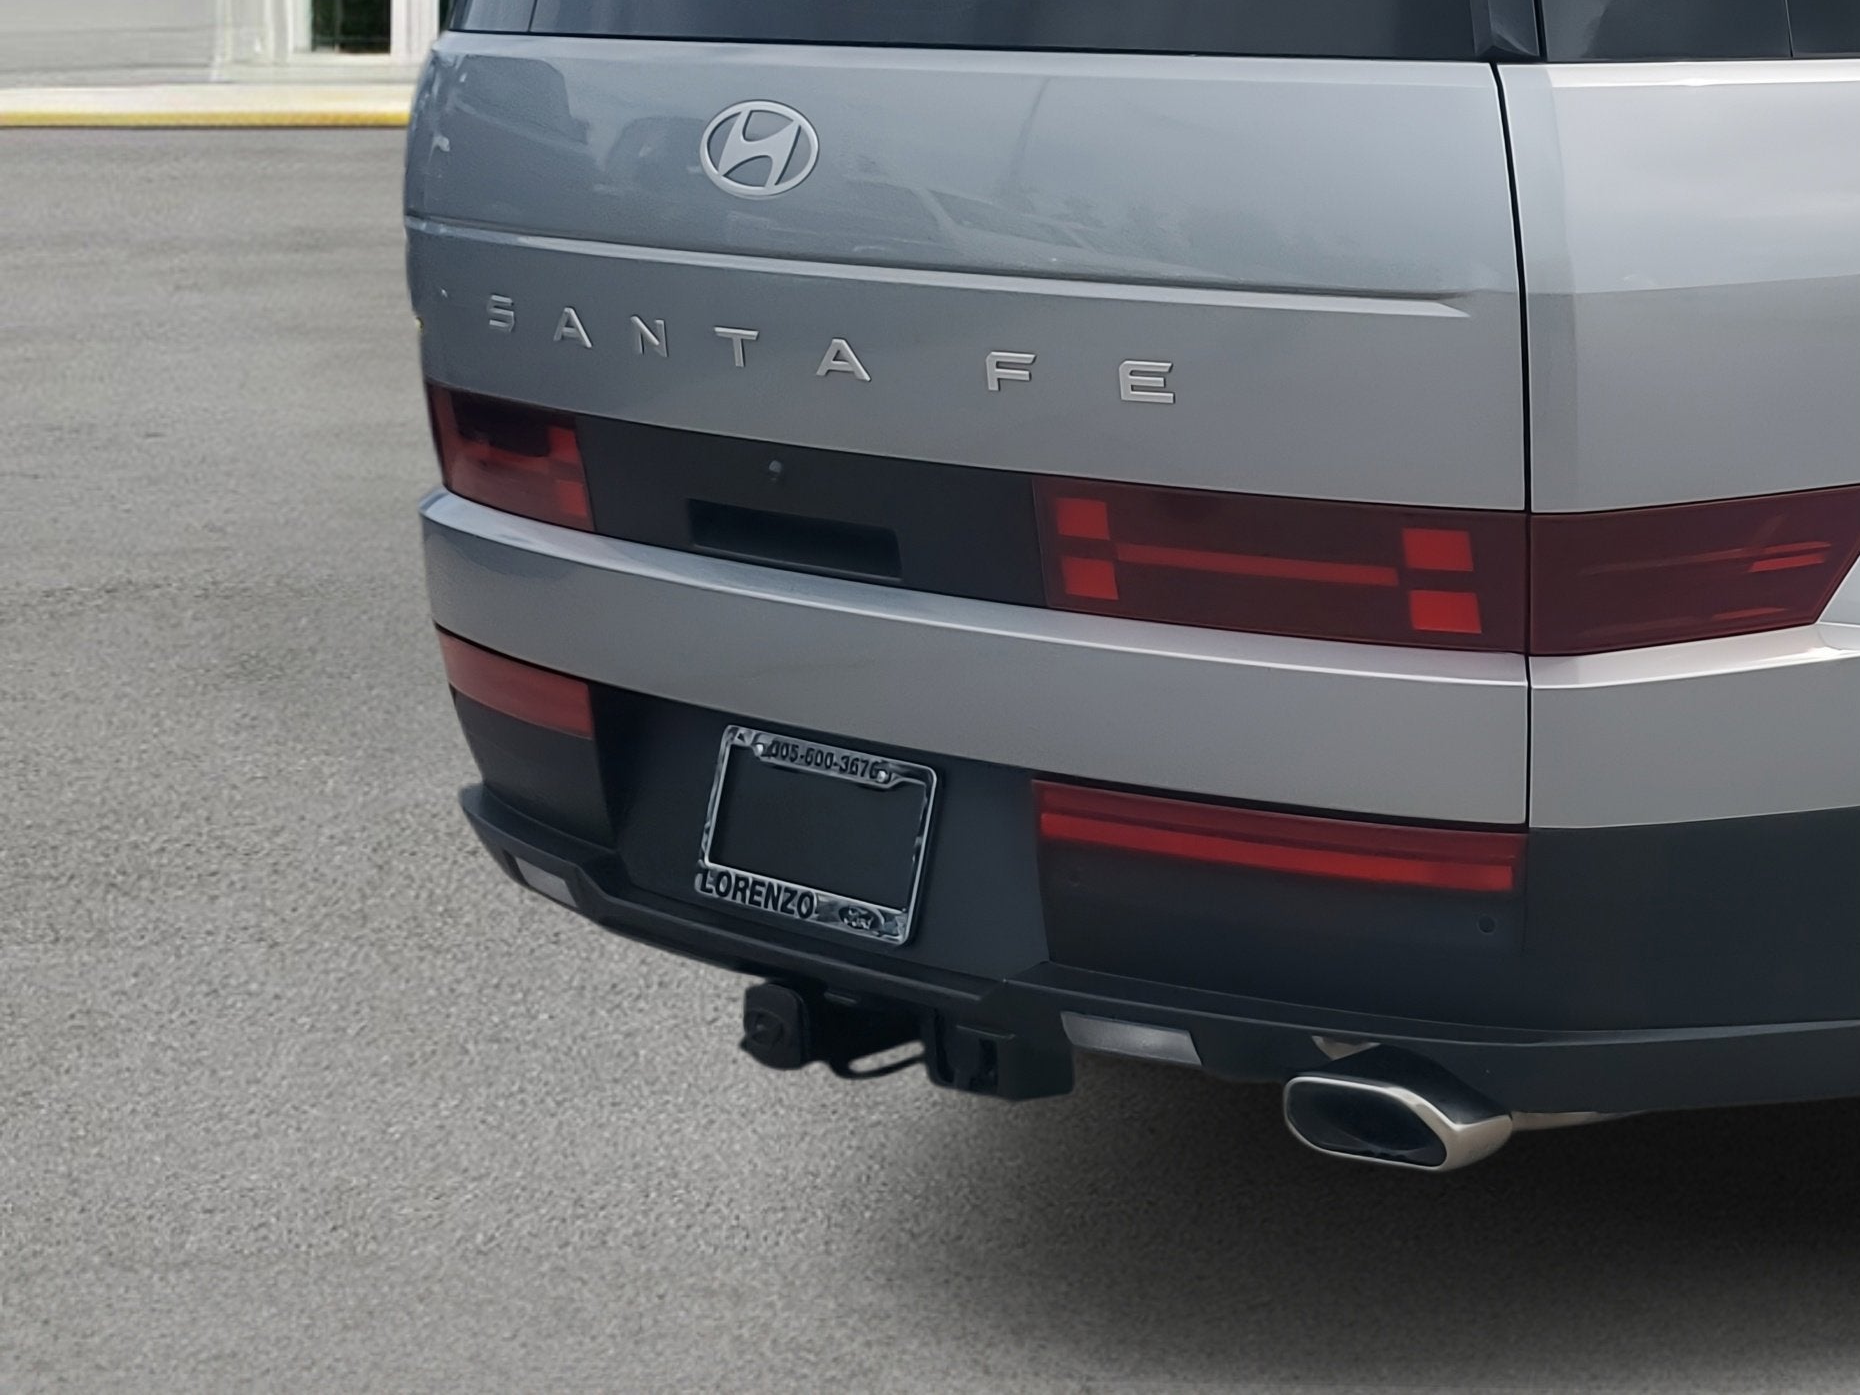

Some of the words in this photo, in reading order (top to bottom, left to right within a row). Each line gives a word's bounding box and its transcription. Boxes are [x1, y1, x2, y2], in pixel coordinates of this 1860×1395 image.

[486, 294, 872, 383] SANTA
[984, 349, 1177, 405] FE
[699, 869, 815, 920] LORENZO
